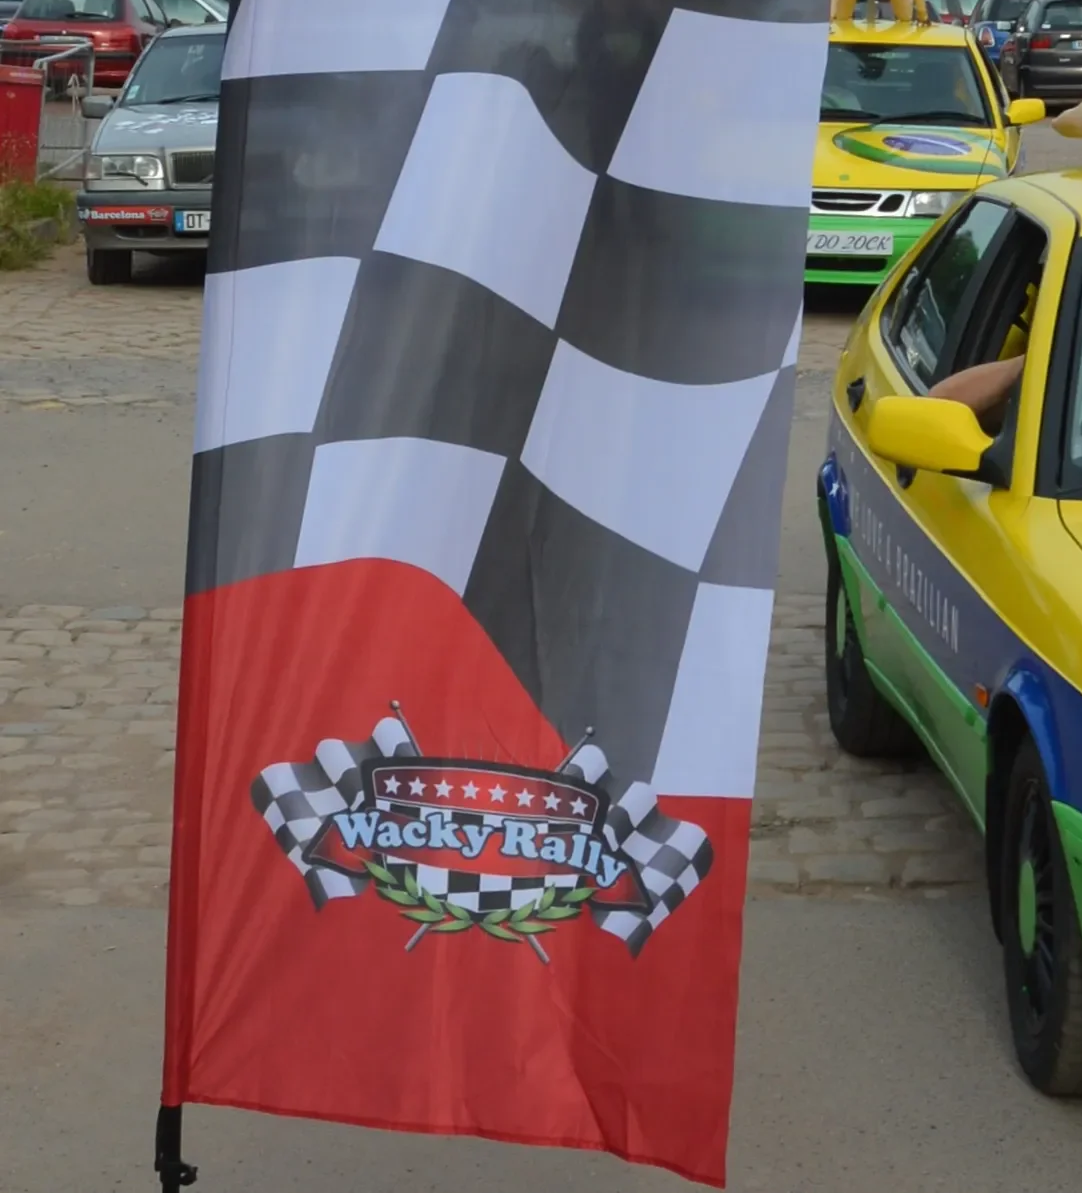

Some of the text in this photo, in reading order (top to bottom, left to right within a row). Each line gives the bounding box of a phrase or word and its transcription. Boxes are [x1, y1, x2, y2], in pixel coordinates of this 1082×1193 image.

[896, 544, 959, 654] BRAZILIAN
[333, 809, 628, 887] Wacky Rally
